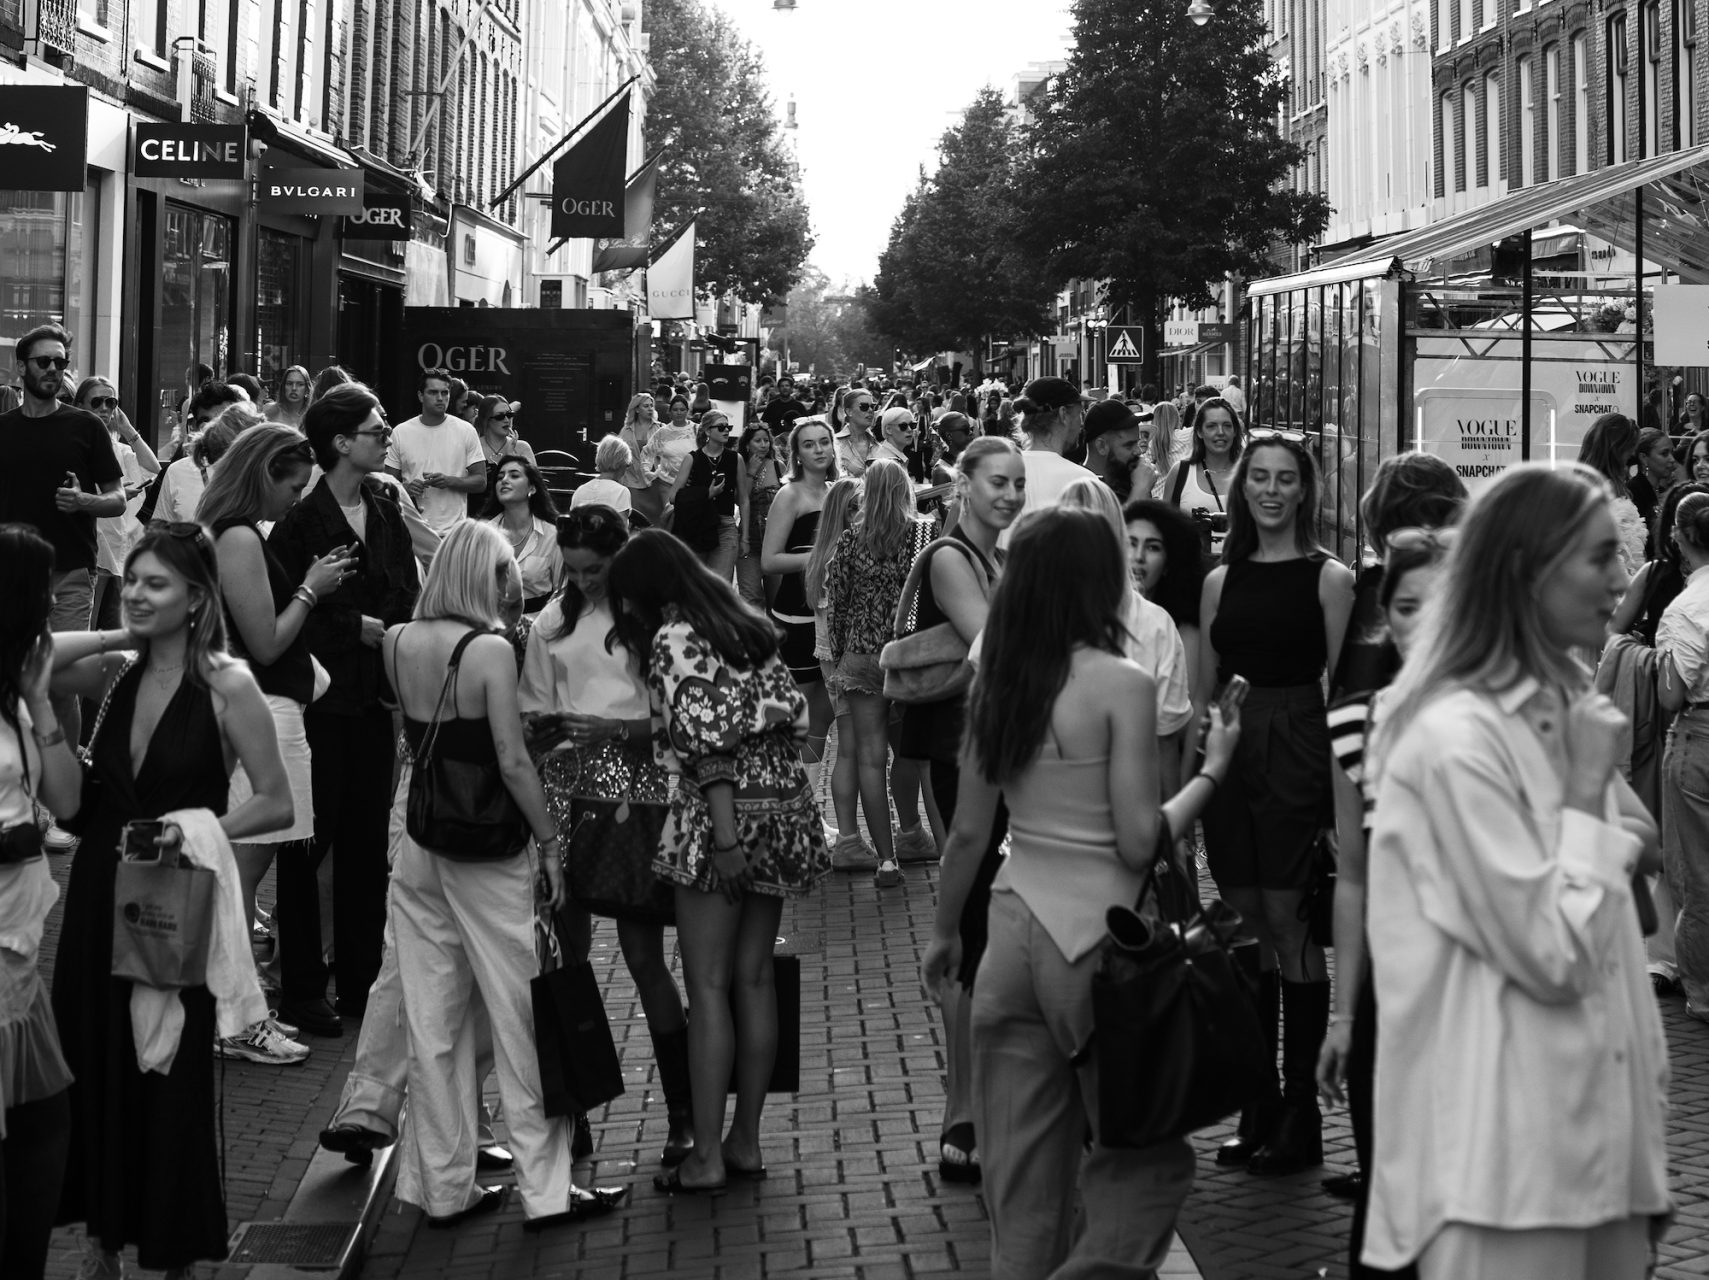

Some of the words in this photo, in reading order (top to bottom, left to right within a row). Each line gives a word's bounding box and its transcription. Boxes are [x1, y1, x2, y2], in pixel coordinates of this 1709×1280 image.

[140, 138, 238, 163] CELINE
[270, 185, 357, 198] BVLGARI
[652, 288, 690, 298] GUCCI
[1169, 327, 1194, 336] DIOR
[1576, 370, 1620, 384] VOGUE
[1578, 383, 1616, 394] DOWNTOWN
[1574, 404, 1612, 414] SNAPCHAT
[1456, 419, 1517, 437] VOGUE
[1461, 436, 1512, 450] DOWNTOWN
